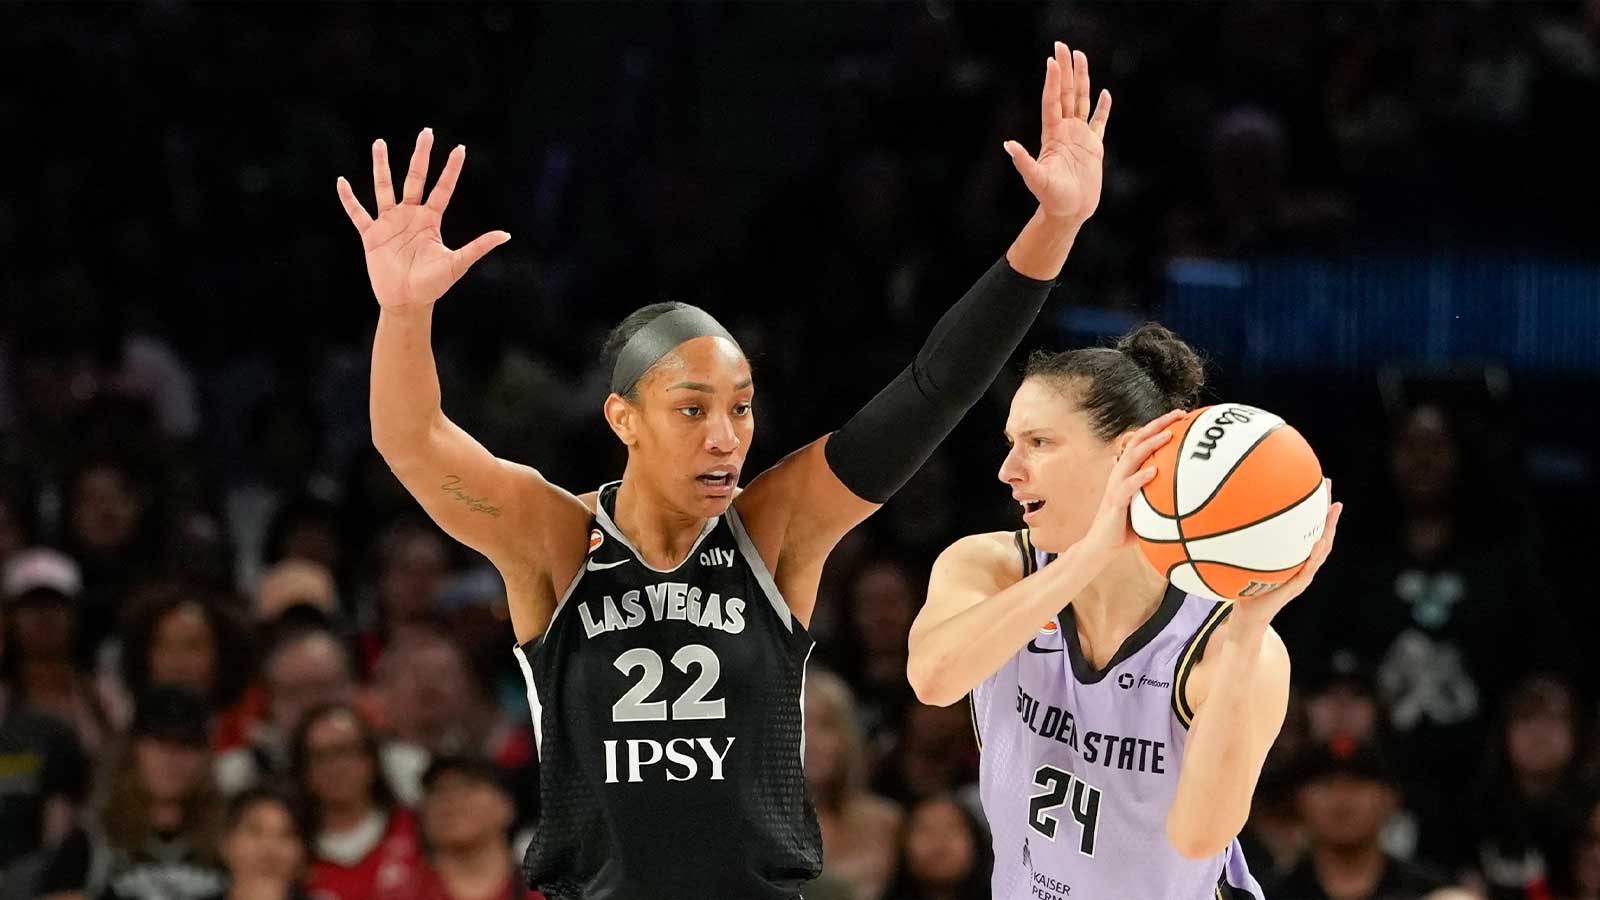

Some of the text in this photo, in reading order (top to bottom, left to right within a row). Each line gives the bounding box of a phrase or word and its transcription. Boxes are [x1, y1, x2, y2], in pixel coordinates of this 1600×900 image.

[1190, 407, 1258, 461] ilson
[700, 547, 735, 568] ally
[577, 582, 746, 639] LAS VEGAS
[612, 644, 726, 722] 22
[603, 737, 736, 783] IPSY
[1083, 731, 1165, 774] STATE
[1028, 764, 1103, 858] 24
[1033, 871, 1071, 896] KAISER
